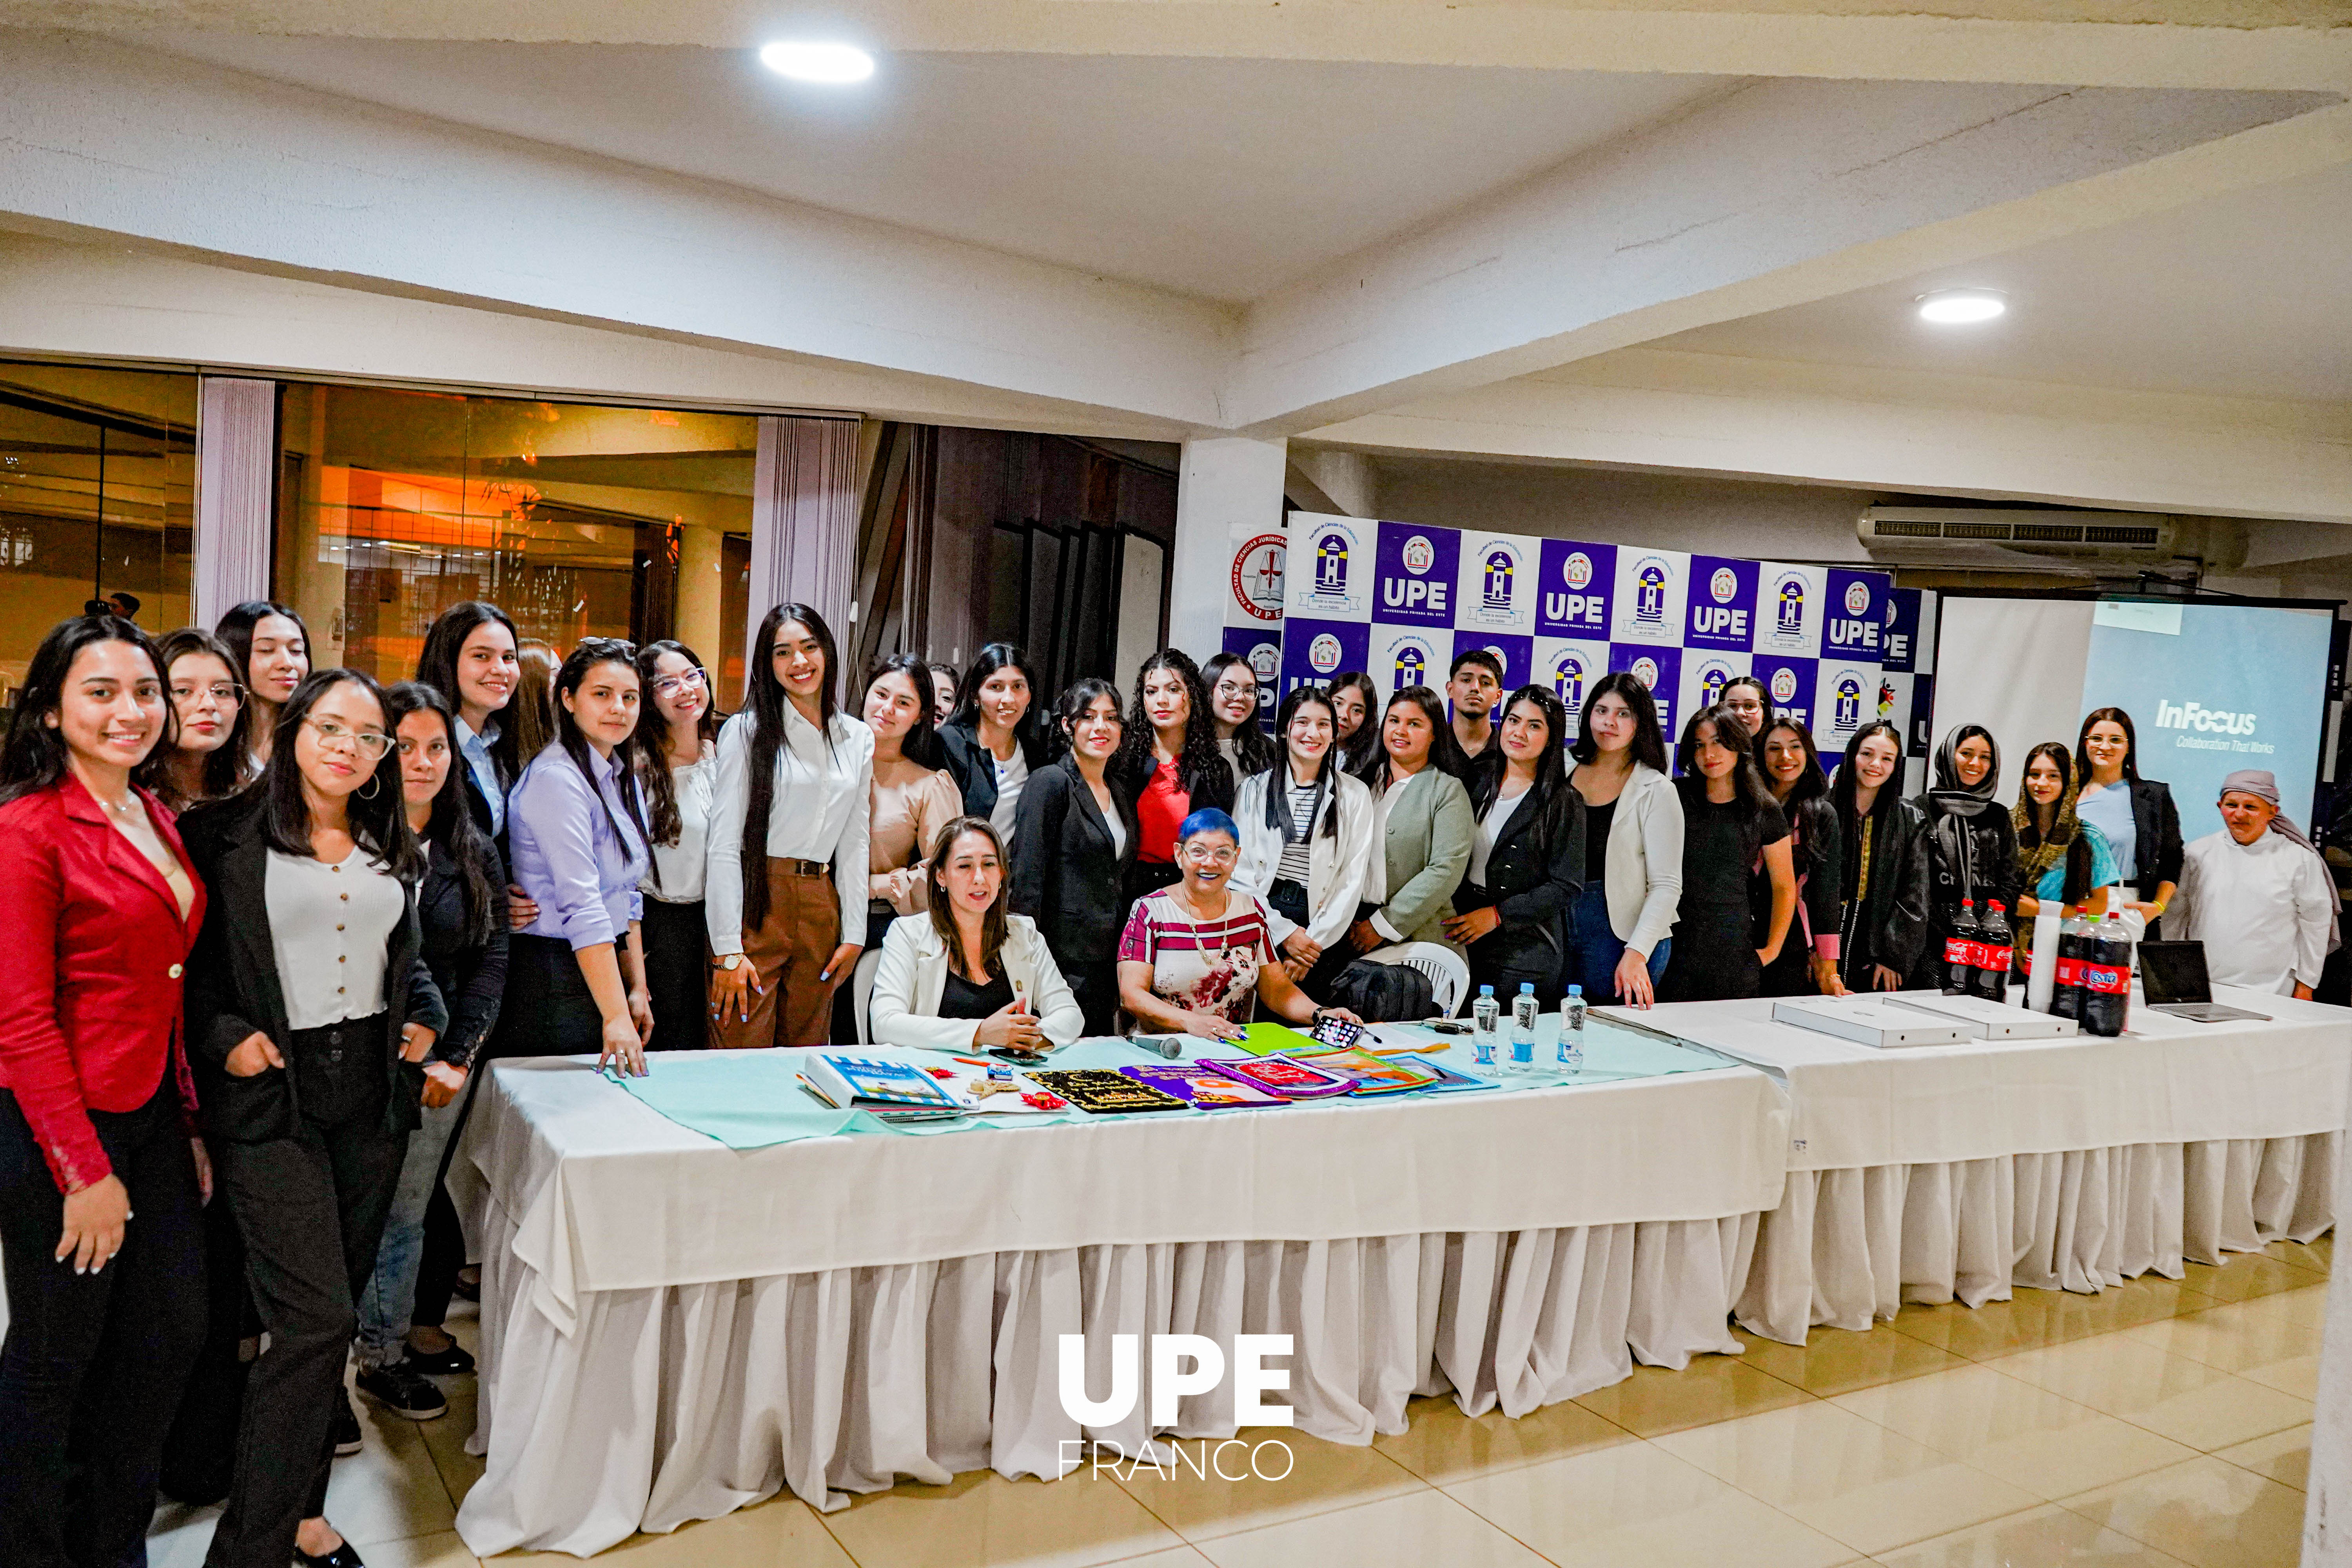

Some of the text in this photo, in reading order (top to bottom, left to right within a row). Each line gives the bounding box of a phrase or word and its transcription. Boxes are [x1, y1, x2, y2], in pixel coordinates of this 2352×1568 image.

[1238, 540, 1257, 563] CIENCIAS
[1234, 574, 1247, 605] FACULTAD
[1384, 577, 1447, 610] UPE
[1546, 592, 1604, 623] UPE
[1694, 606, 1748, 635] UPE
[1830, 618, 1879, 646] UPE
[2155, 699, 2257, 735] InFocus
[2176, 735, 2275, 755] Collaboration That Works
